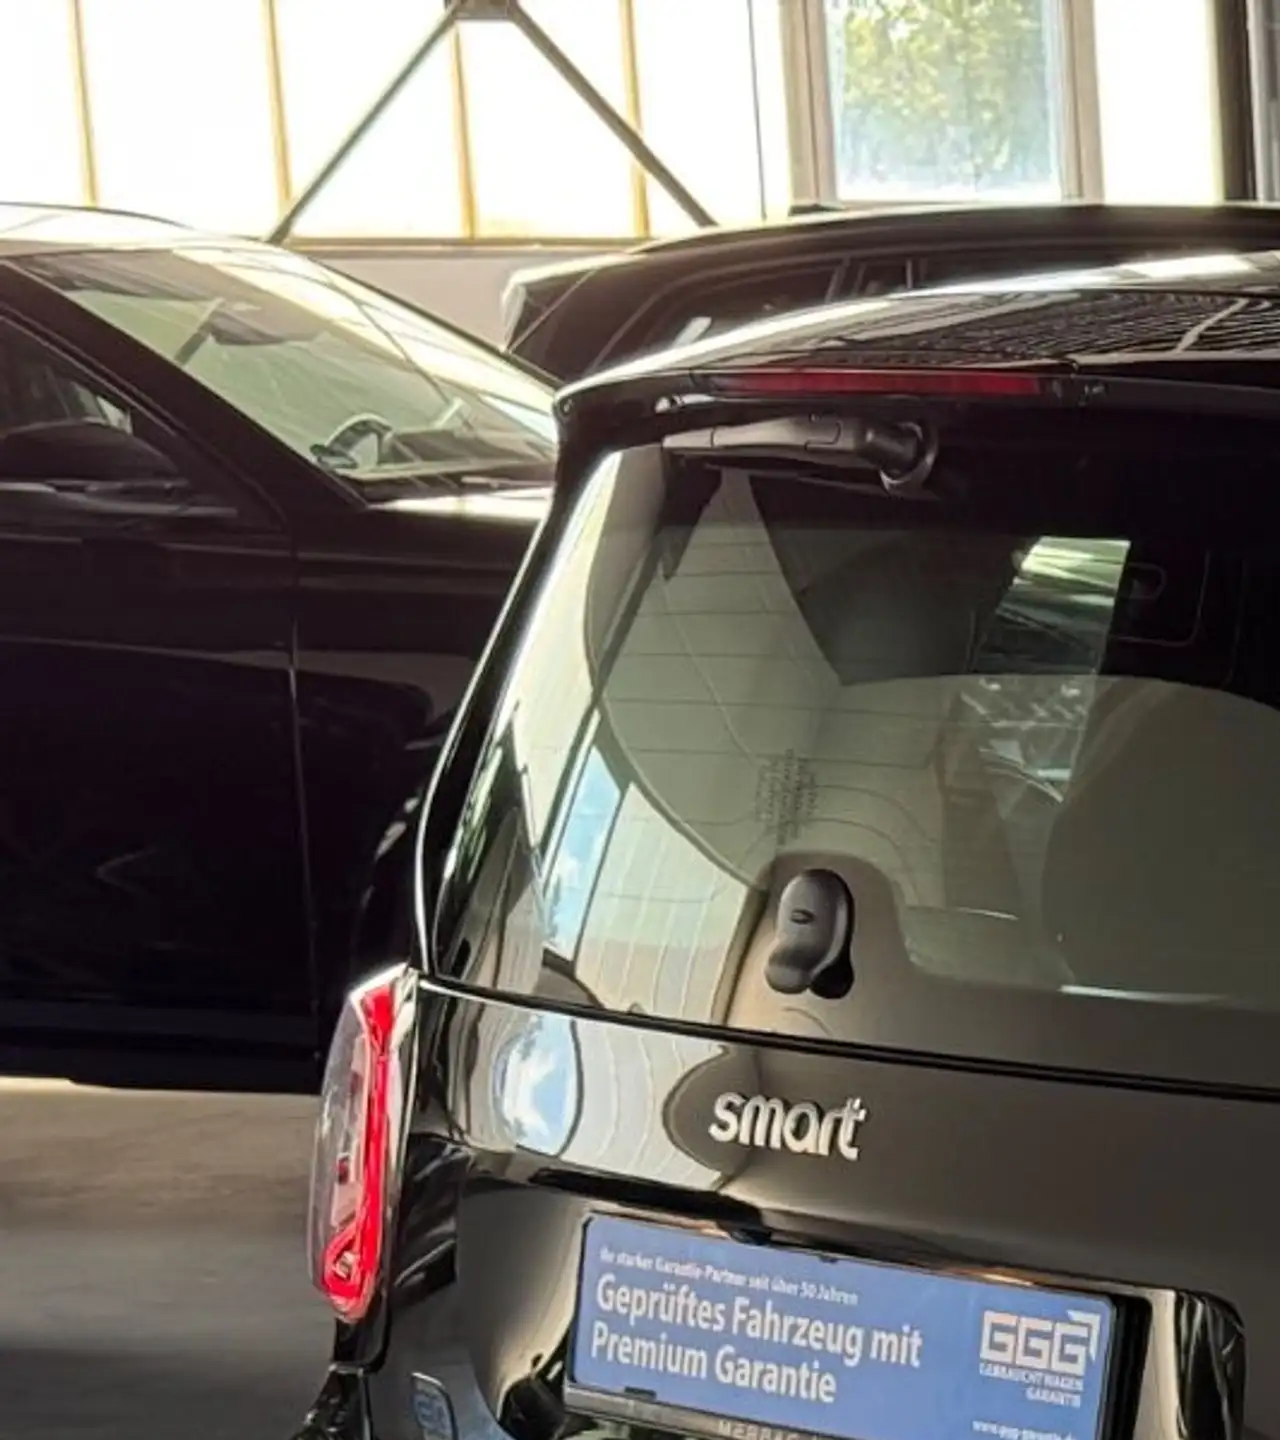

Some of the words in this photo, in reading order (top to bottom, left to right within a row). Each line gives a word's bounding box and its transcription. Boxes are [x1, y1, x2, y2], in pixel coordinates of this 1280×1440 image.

[708, 1091, 868, 1162] smart
[616, 1252, 653, 1270] starker
[816, 1283, 859, 1305] Jahren
[596, 1272, 726, 1332] Geprüftes
[731, 1295, 864, 1368] Fahrzeug
[869, 1324, 923, 1369] mit
[980, 1310, 1089, 1378] GGG
[591, 1321, 708, 1380] Premium
[715, 1344, 837, 1404] Garantie
